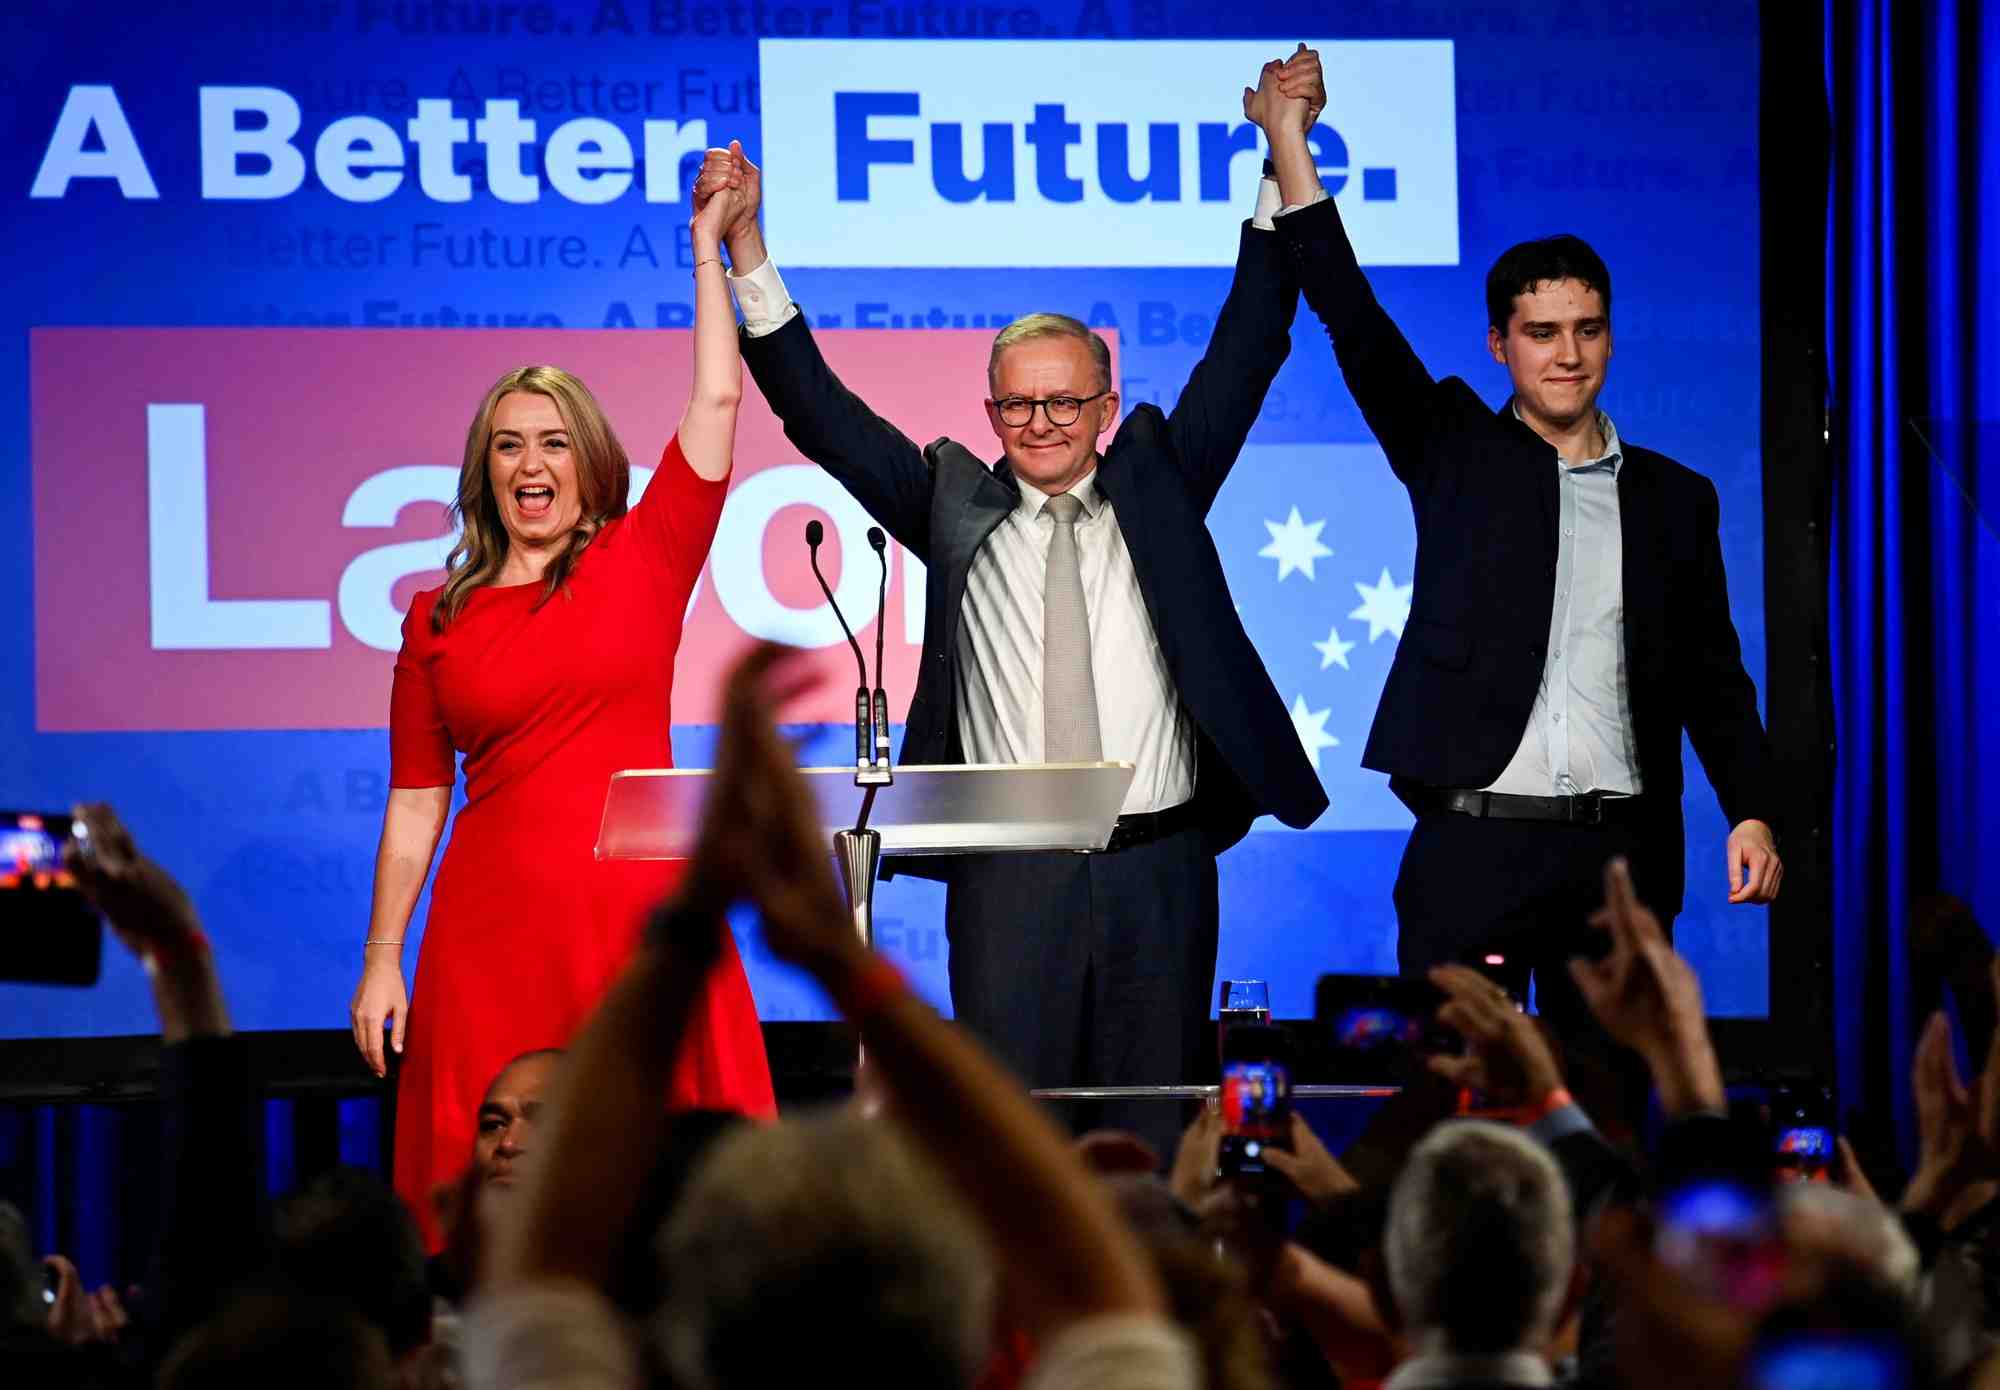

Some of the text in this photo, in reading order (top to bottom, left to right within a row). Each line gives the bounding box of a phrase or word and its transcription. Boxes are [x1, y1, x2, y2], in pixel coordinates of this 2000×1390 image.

[29, 85, 708, 205] A Better
[411, 223, 603, 270] Future.
[617, 226, 661, 270] A
